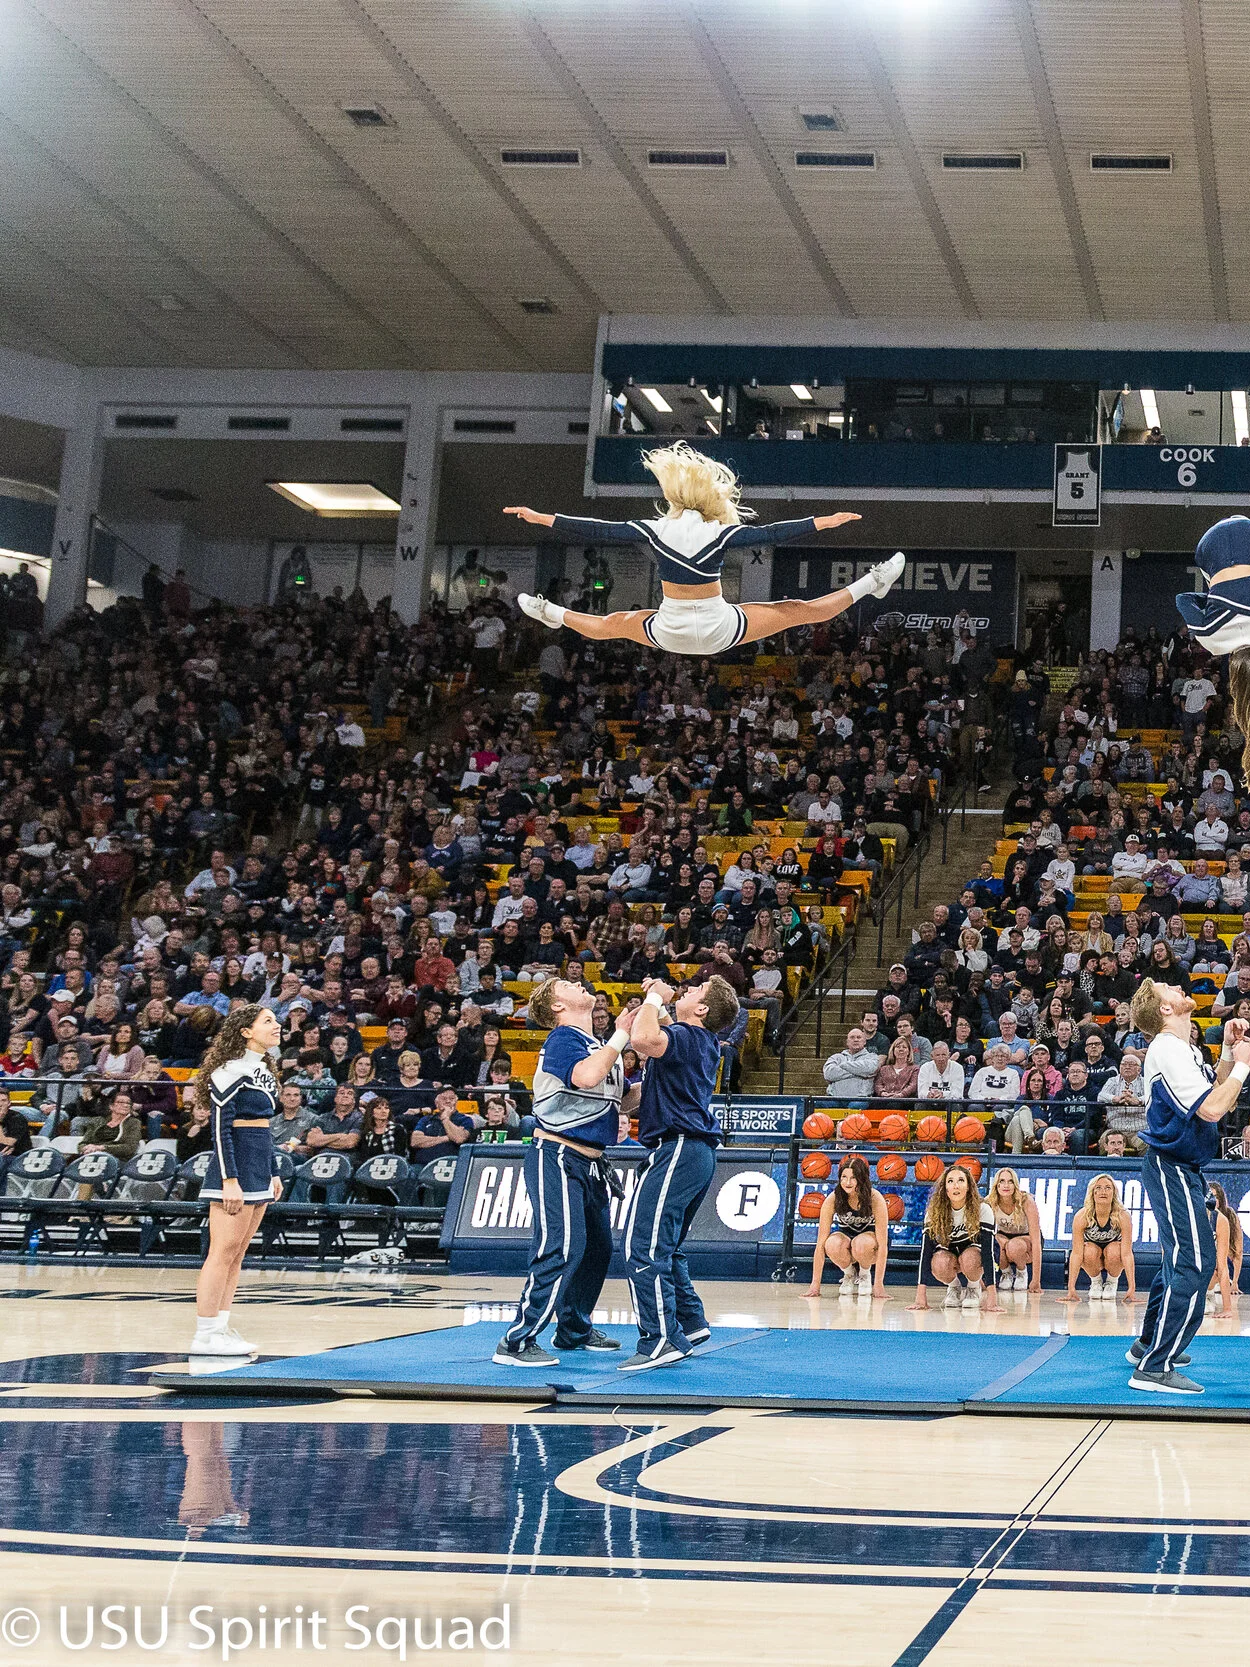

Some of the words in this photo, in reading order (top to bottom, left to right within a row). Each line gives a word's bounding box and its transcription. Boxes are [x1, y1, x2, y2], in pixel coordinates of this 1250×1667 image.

[1159, 448, 1215, 463] COOK
[1177, 462, 1197, 487] 6
[1070, 482, 1084, 499] 5
[400, 546, 419, 560] W
[750, 550, 763, 565] X
[1100, 556, 1114, 571] A
[798, 561, 808, 589] I
[776, 864, 800, 875] LOVE
[741, 1110, 791, 1121] SPORTS
[471, 1166, 534, 1228] GAM
[734, 1184, 761, 1217] F
